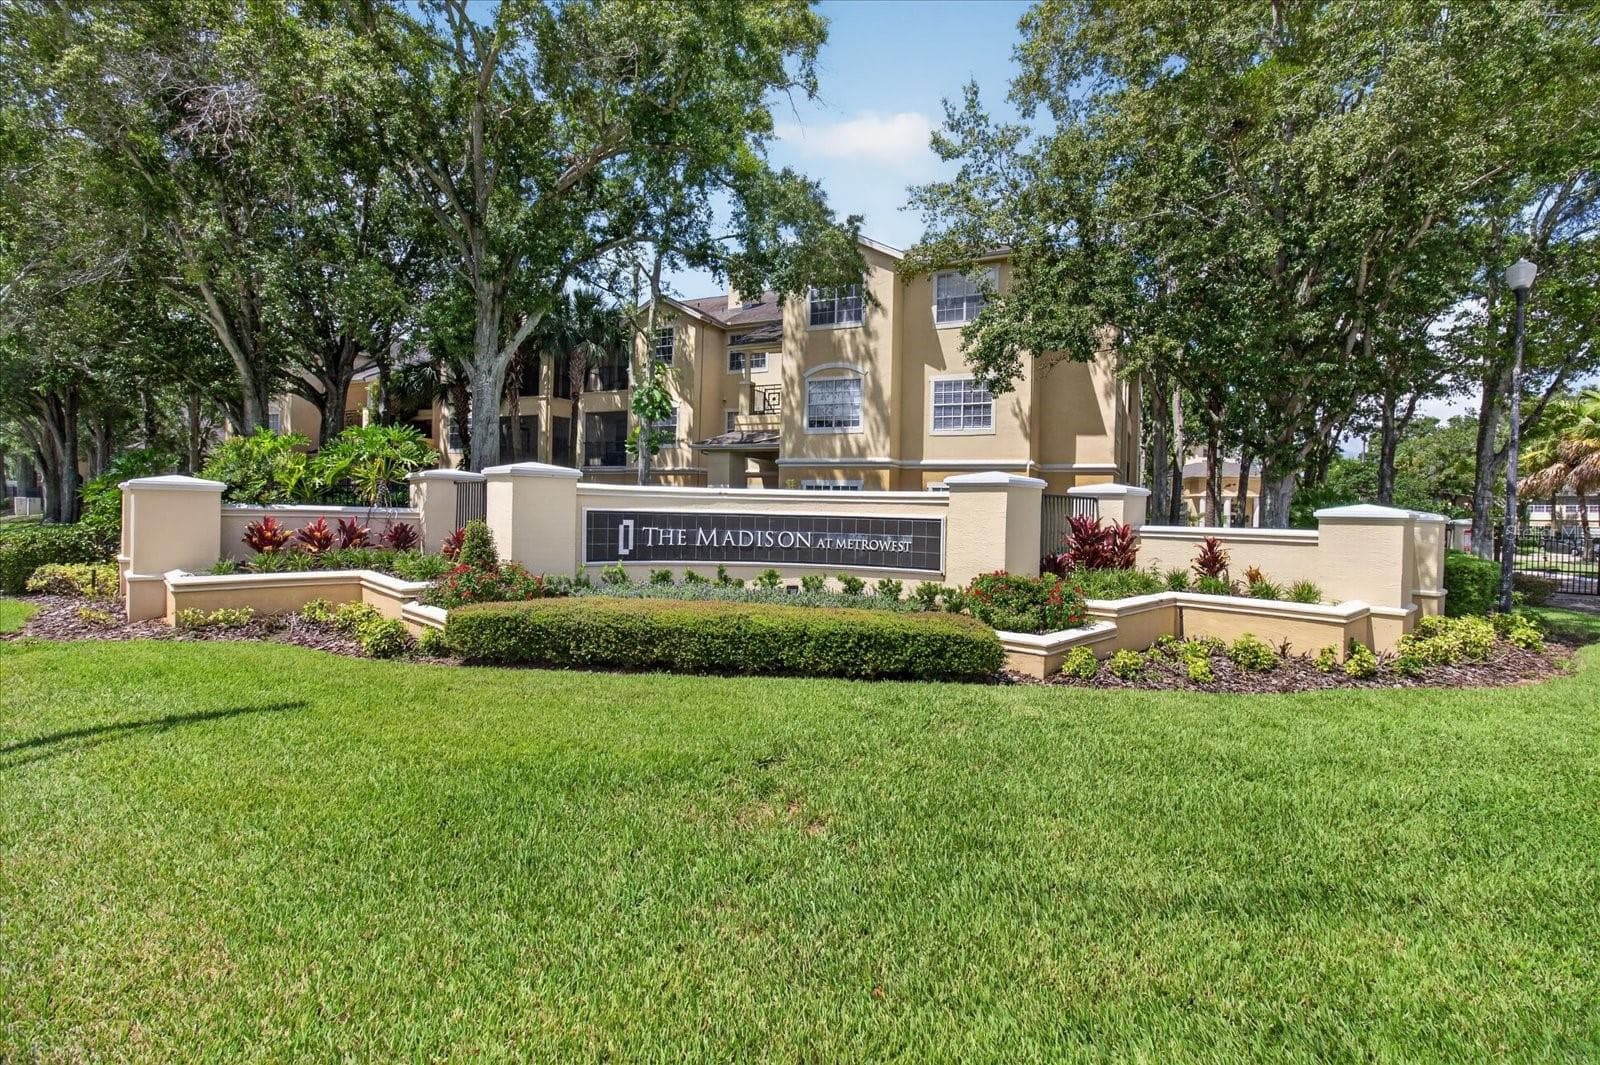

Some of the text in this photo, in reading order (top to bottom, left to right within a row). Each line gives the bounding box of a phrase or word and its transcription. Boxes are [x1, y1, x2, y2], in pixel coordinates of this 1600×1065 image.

[642, 526, 913, 553] THE MADISON AT METROWEST
